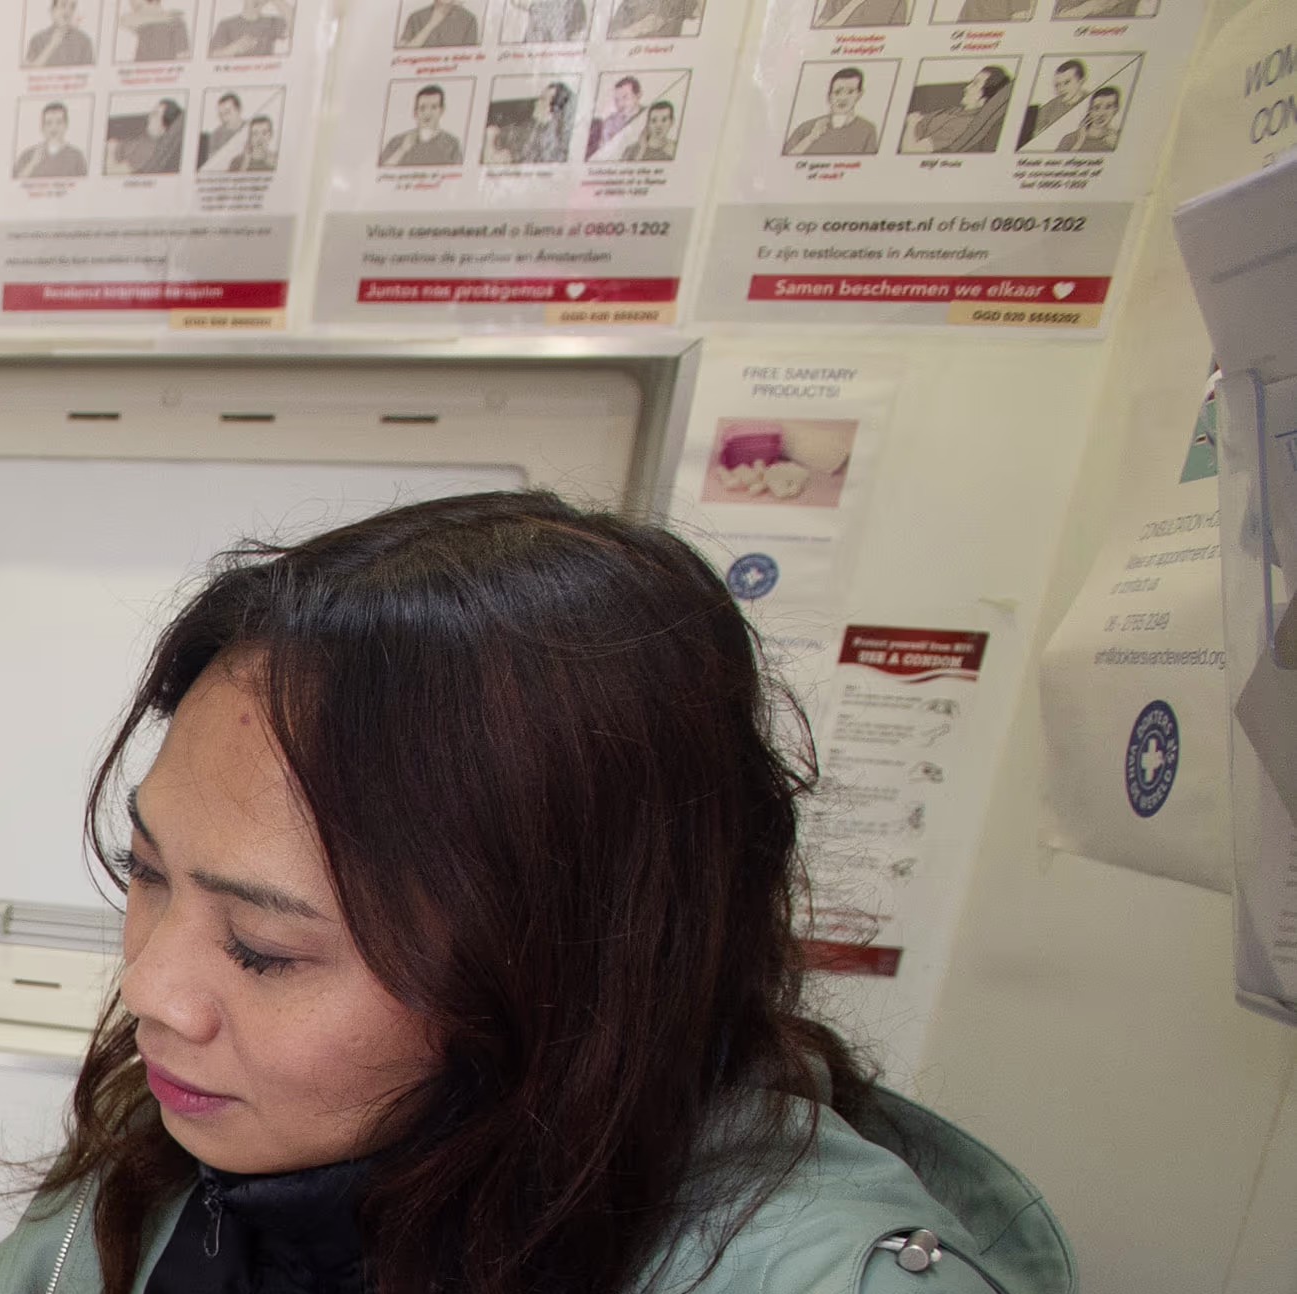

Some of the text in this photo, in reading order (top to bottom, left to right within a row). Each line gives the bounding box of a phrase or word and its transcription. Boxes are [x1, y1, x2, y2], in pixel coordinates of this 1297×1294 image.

[584, 221, 670, 236] 0800-1202
[764, 216, 1087, 237] Kijk op coronatest.nl of bel 0800-1202
[758, 246, 989, 262] Er zijn testlocaties in Amsterdam
[366, 281, 554, 302] Juntos nos protegemos
[775, 279, 1046, 298] Samen beschermen we elkaar
[972, 310, 1000, 322] GGD
[741, 367, 857, 381] FREE SANITARY
[857, 650, 965, 668] USE A CONDOM
